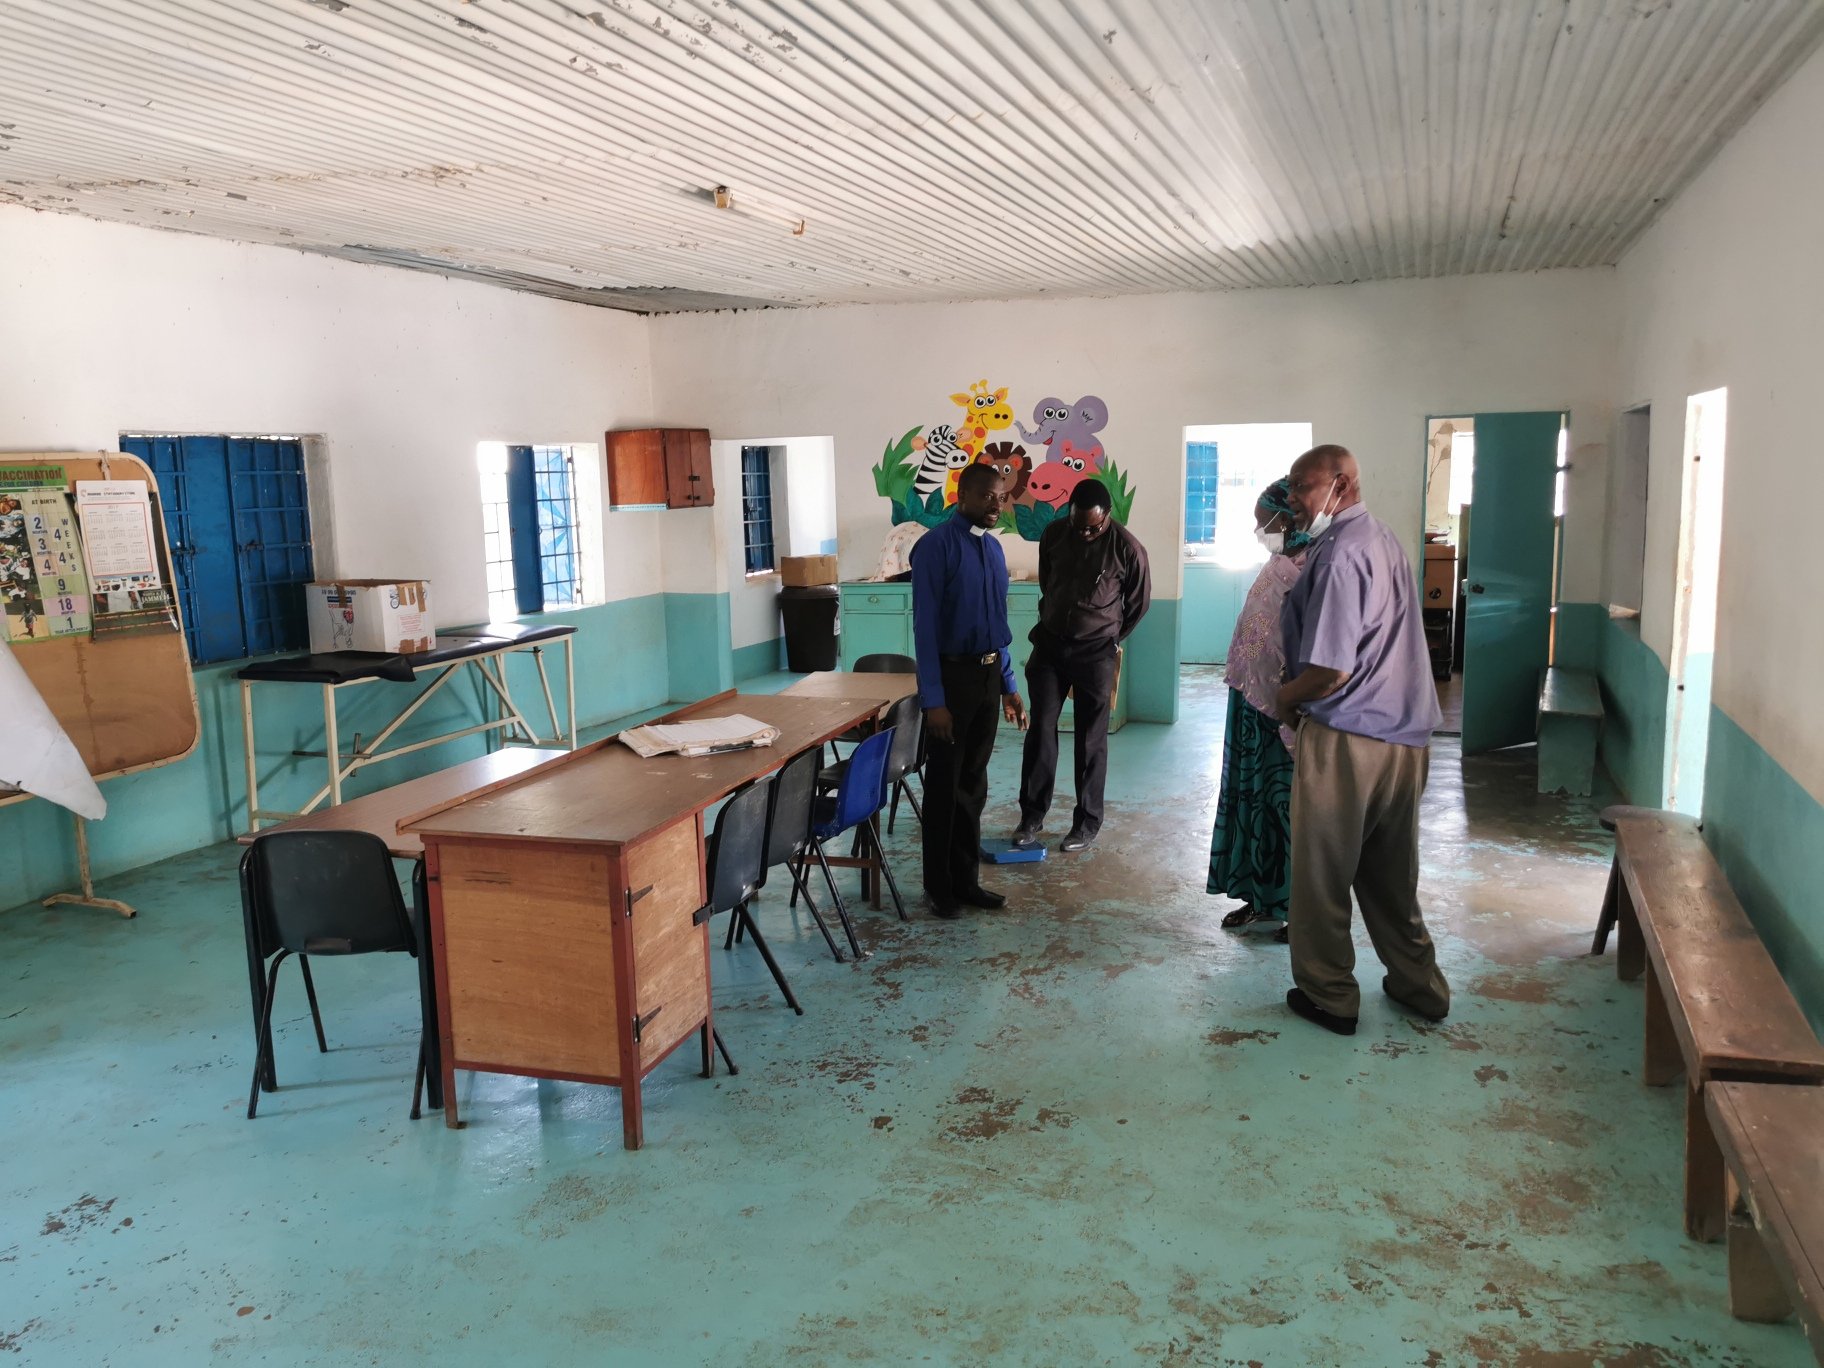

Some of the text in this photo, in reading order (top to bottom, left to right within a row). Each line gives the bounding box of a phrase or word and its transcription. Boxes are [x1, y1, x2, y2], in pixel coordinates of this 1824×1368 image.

[33, 516, 42, 530] 2
[54, 528, 62, 541] 4
[38, 537, 47, 551] 3
[59, 551, 67, 565] 4
[44, 559, 52, 571] 4
[58, 578, 66, 591] 9
[58, 597, 73, 611] 18
[67, 616, 73, 629] 1
